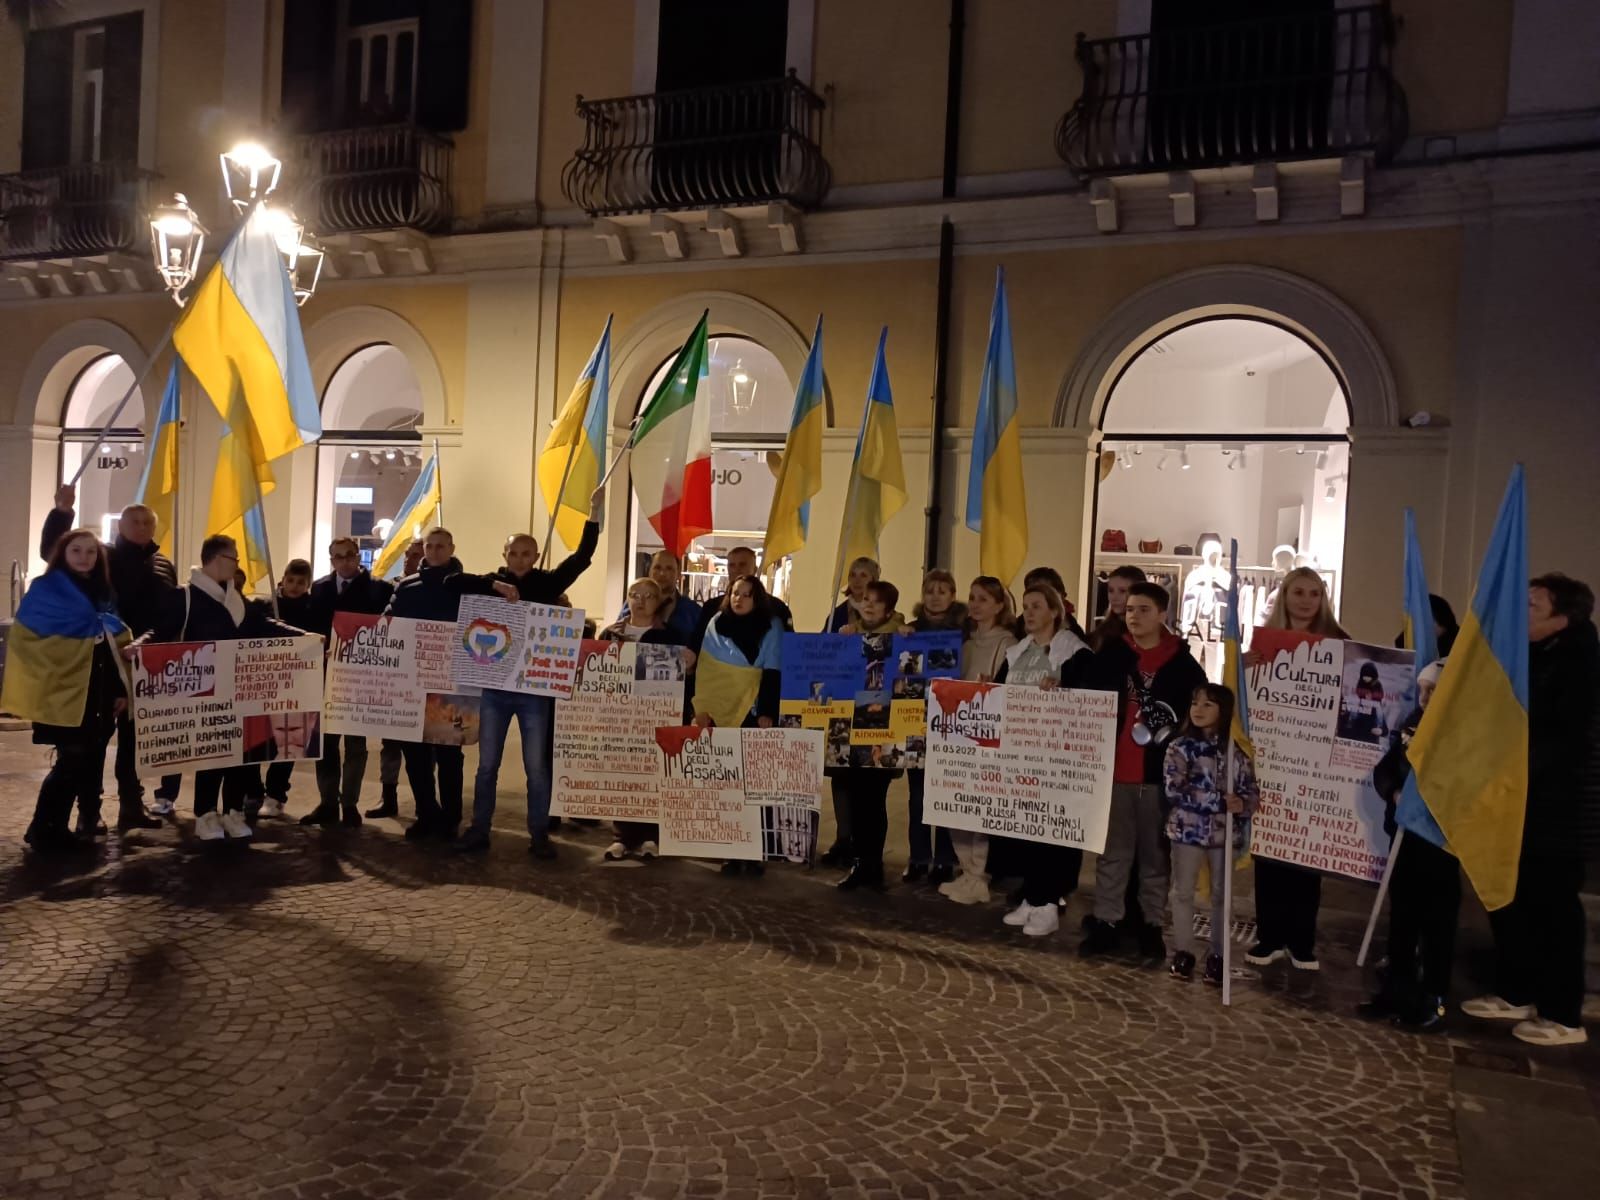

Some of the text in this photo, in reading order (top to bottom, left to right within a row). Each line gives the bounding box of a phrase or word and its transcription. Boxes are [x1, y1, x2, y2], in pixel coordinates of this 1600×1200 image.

[548, 607, 573, 619] PETS
[357, 630, 405, 650] CULTURA
[550, 624, 580, 640] KIDS
[247, 651, 301, 663] TRIBUNALE
[533, 644, 576, 657] PEOPLES
[1314, 650, 1333, 665] LA
[235, 660, 317, 673] INTERNAZIONALE
[587, 654, 633, 675] CULTURA
[235, 672, 274, 684] EMESSO
[1274, 662, 1341, 688] CULTURA
[1295, 683, 1322, 693] DEGLI
[264, 699, 299, 711] PUTIN
[1256, 686, 1335, 711] ASSASINI
[137, 699, 233, 719] QUANDO TU FINANZI
[958, 710, 1002, 722] CULTURA
[151, 720, 196, 733] CULTURA
[201, 715, 236, 727] RUSSA
[151, 745, 192, 763] BAMBINI
[195, 739, 232, 757] UCRAINI
[685, 741, 733, 757] CULTURA
[687, 755, 710, 765] DEGLI
[1297, 784, 1306, 797] 9
[1307, 787, 1340, 802] TEATRI
[933, 801, 981, 816] CULTURA
[986, 806, 1017, 820] RUSSA
[1025, 811, 1038, 824] TU
[954, 792, 1066, 815] QUANDO TU FINANZI LA
[703, 820, 742, 831] PENALE
[981, 817, 1086, 843] UCCIDENDO CIVILI
[1252, 817, 1309, 837] CULTURA
[1284, 809, 1299, 821] TU
[1308, 815, 1358, 835] FINANZI
[670, 830, 752, 842] INTERNAZIONALE
[1254, 830, 1306, 850] FINANZI
[1309, 841, 1322, 853] LA
[1264, 845, 1329, 869] CULTURA
